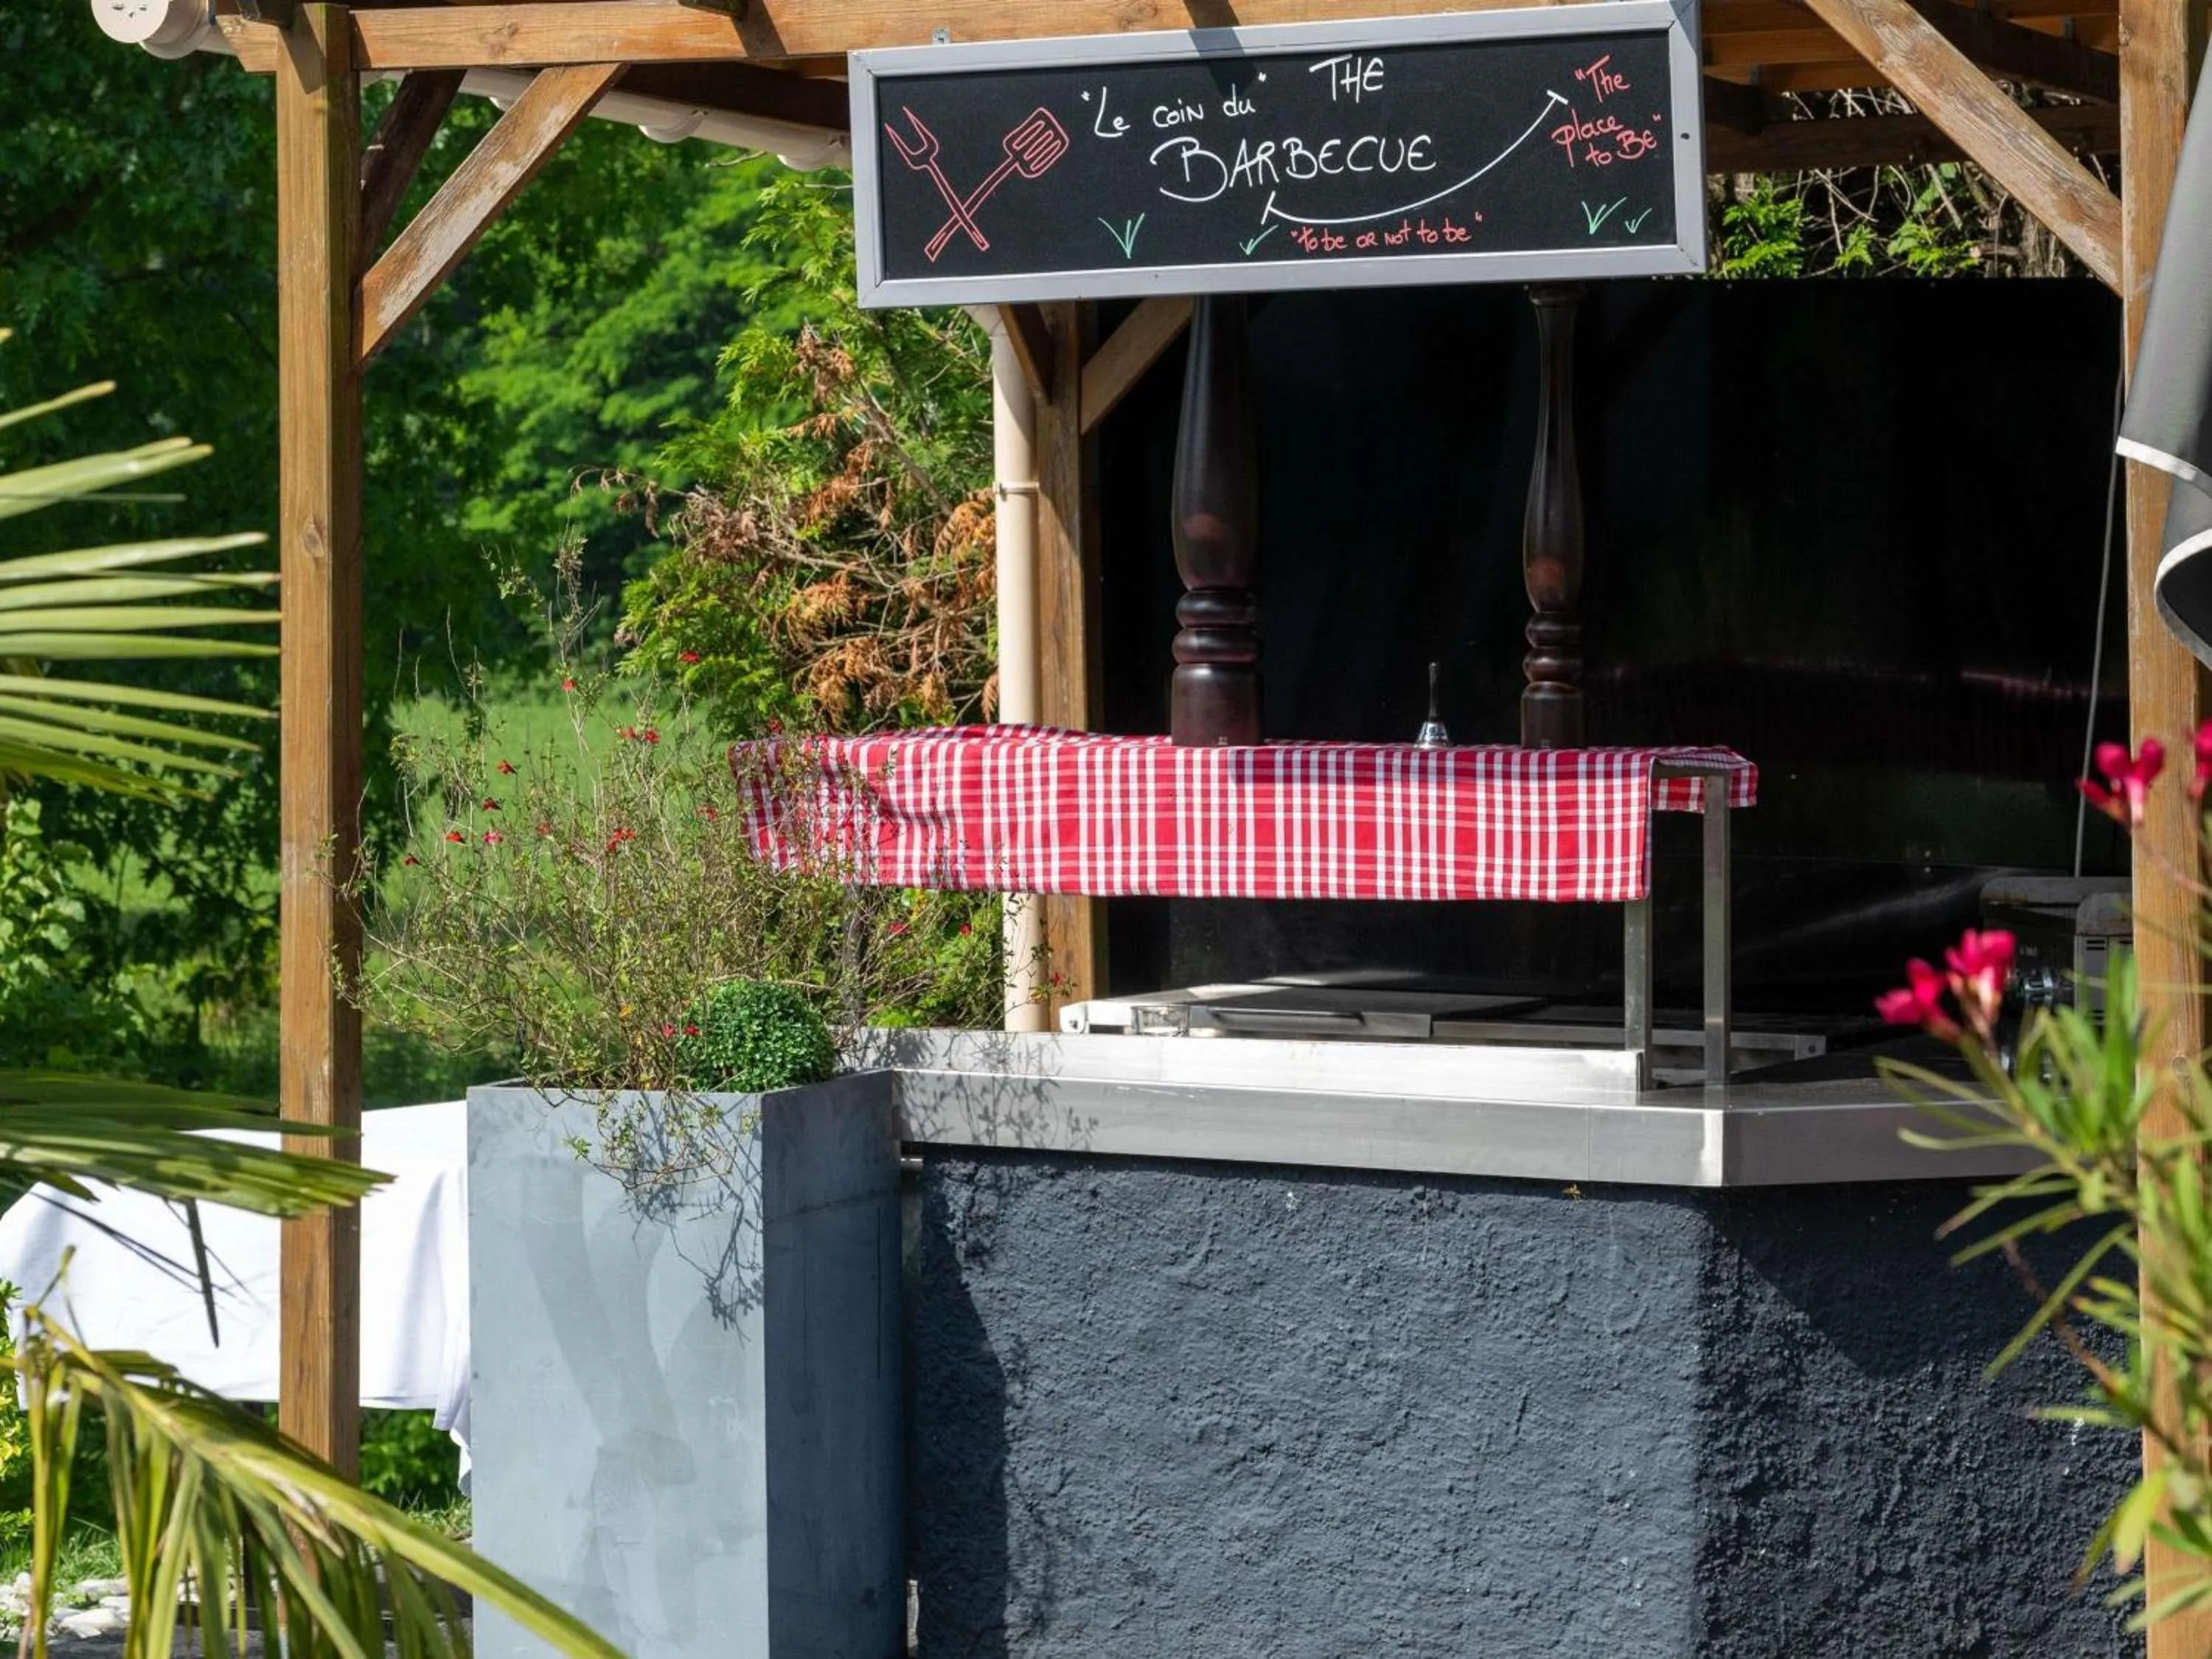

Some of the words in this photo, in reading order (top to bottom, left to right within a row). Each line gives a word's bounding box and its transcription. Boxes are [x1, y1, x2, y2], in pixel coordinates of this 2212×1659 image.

[1309, 54, 1385, 103] THE
[1150, 135, 1437, 203] BARBECUE
[1585, 142, 1613, 167] to
[1321, 229, 1348, 251] be
[1416, 219, 1438, 243] to
